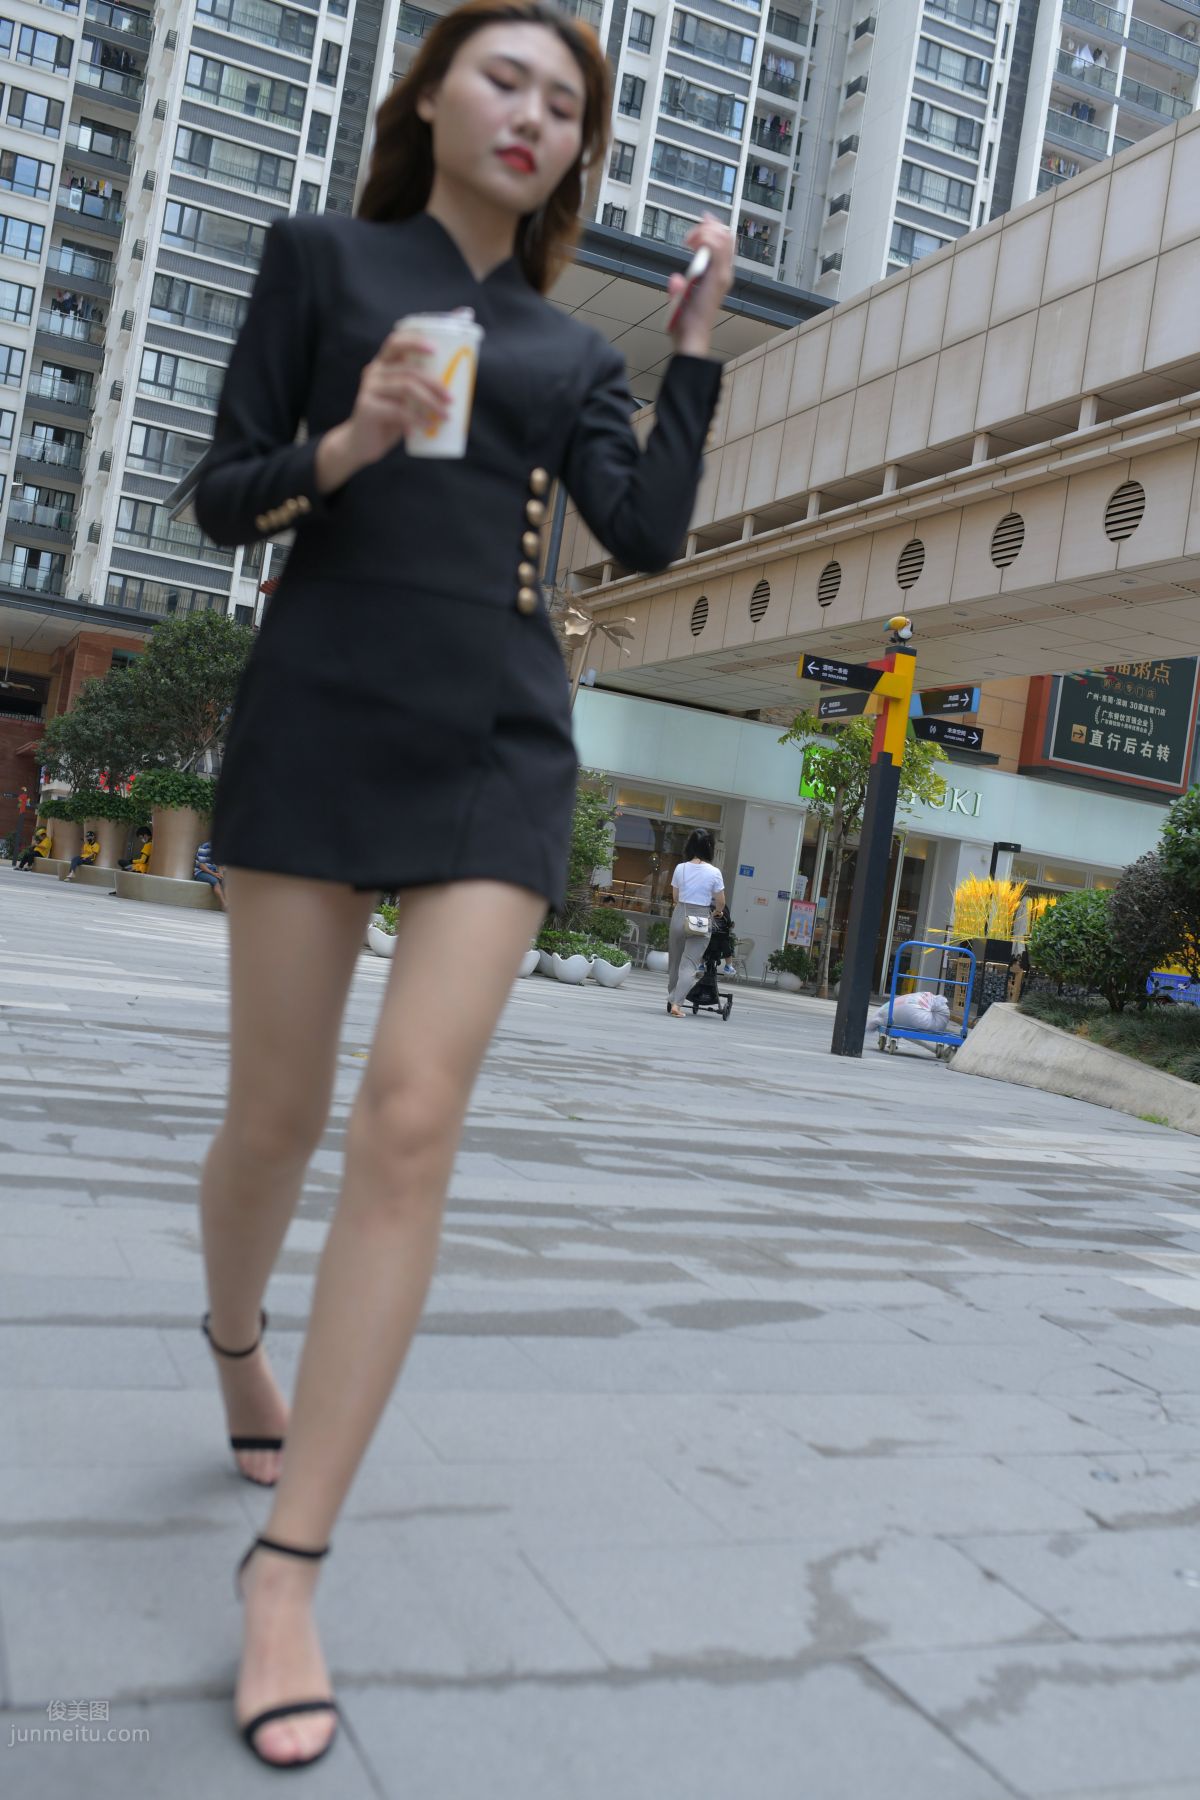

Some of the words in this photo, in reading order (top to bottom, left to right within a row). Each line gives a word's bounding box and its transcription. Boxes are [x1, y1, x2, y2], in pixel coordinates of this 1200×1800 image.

[1088, 729, 1171, 762] 直行后右转
